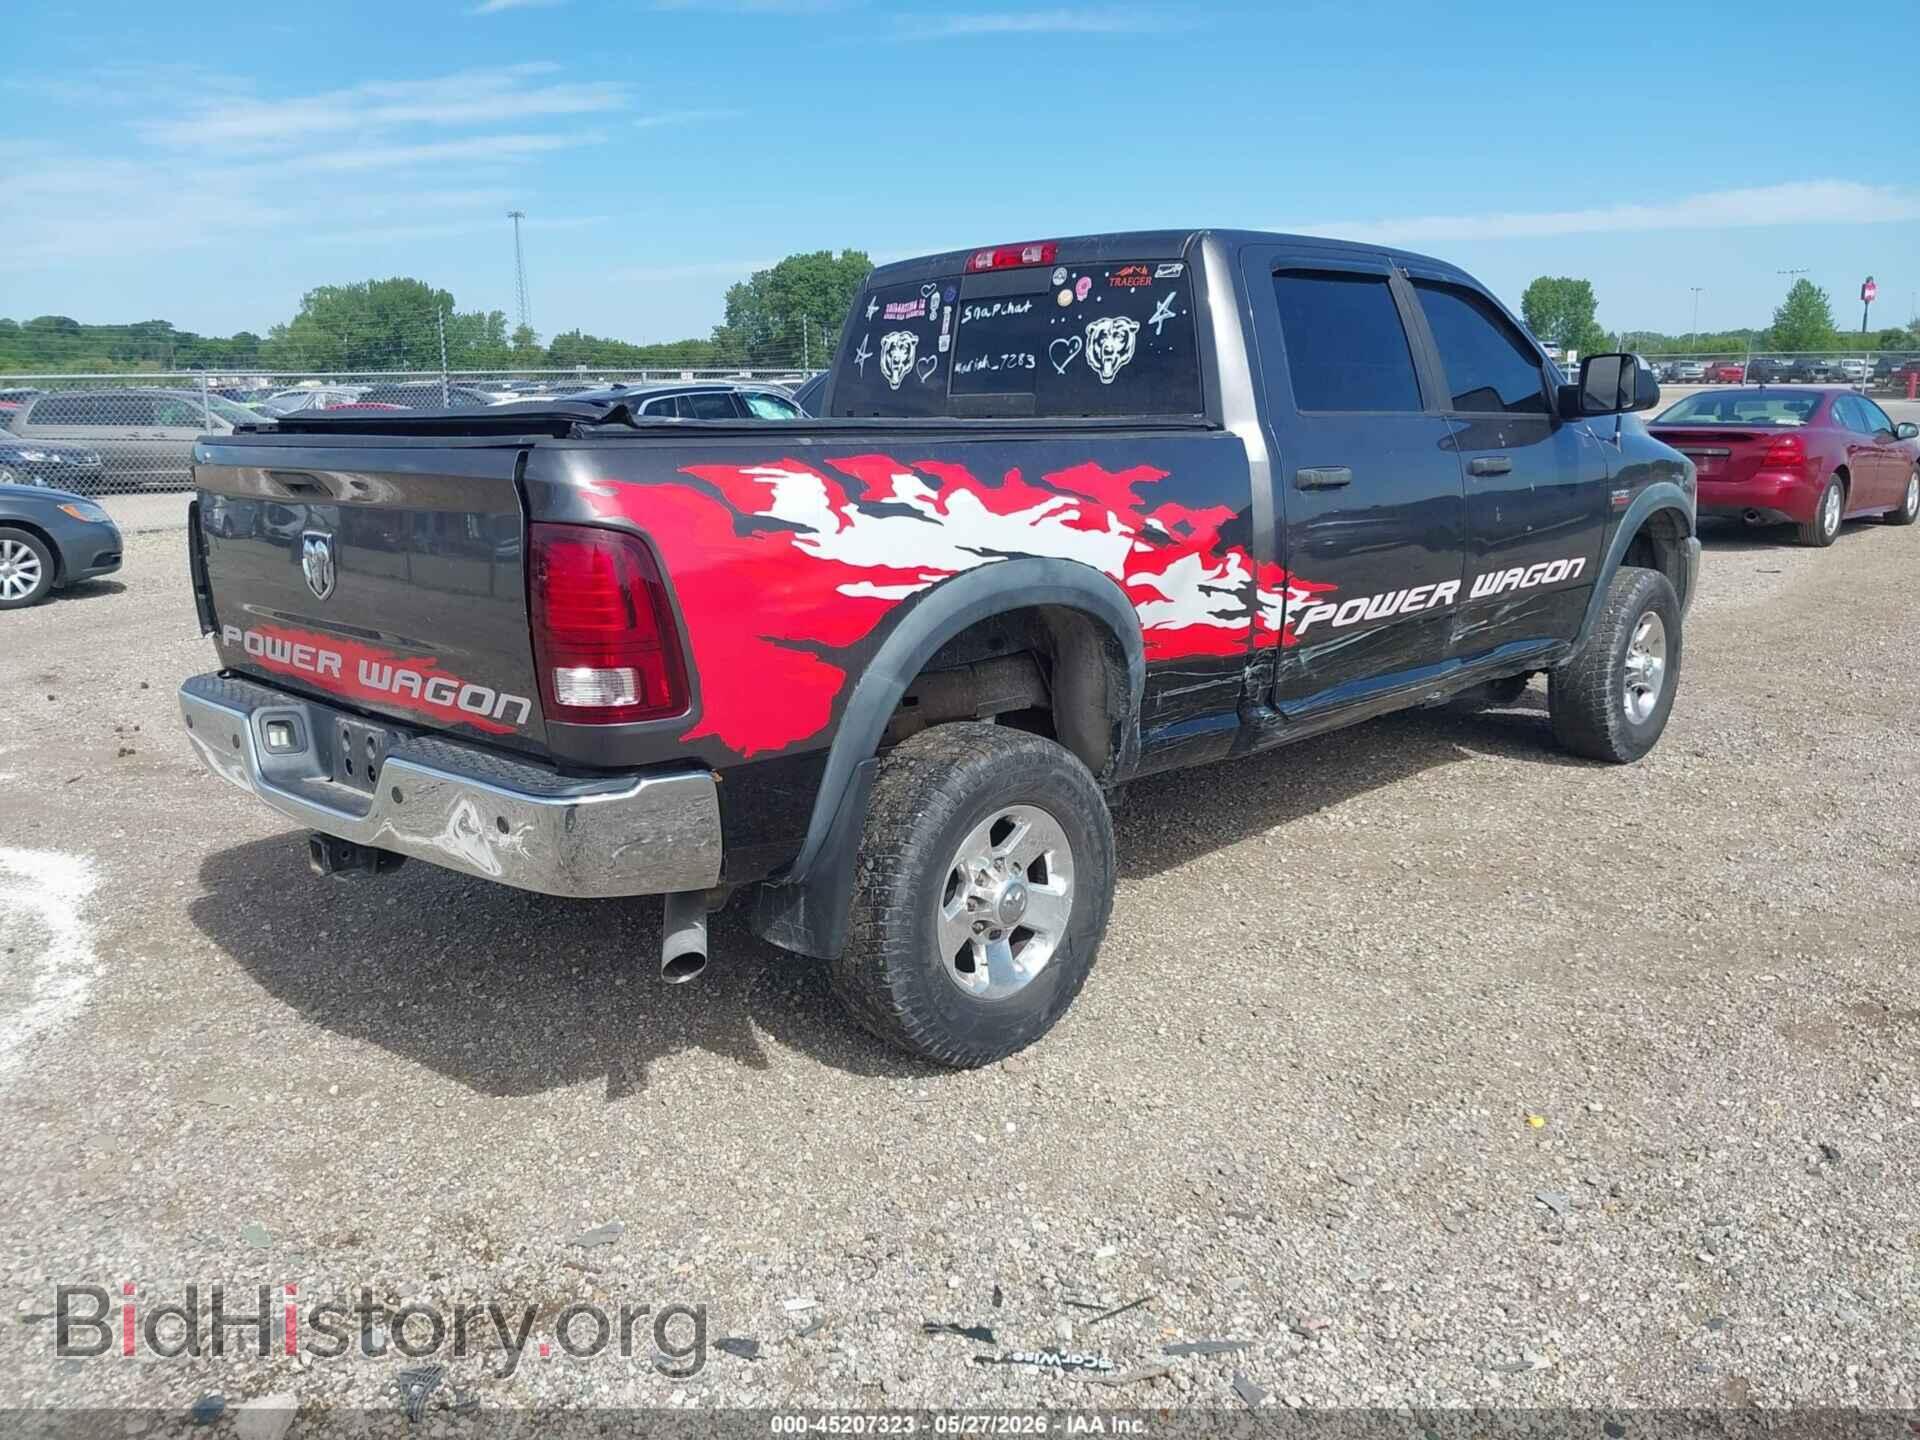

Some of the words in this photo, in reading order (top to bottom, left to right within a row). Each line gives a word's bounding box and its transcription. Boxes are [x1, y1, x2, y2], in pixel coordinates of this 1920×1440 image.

[1109, 276, 1152, 287] TRAEGER
[1295, 579, 1461, 635] POWER
[223, 624, 342, 678] POWER
